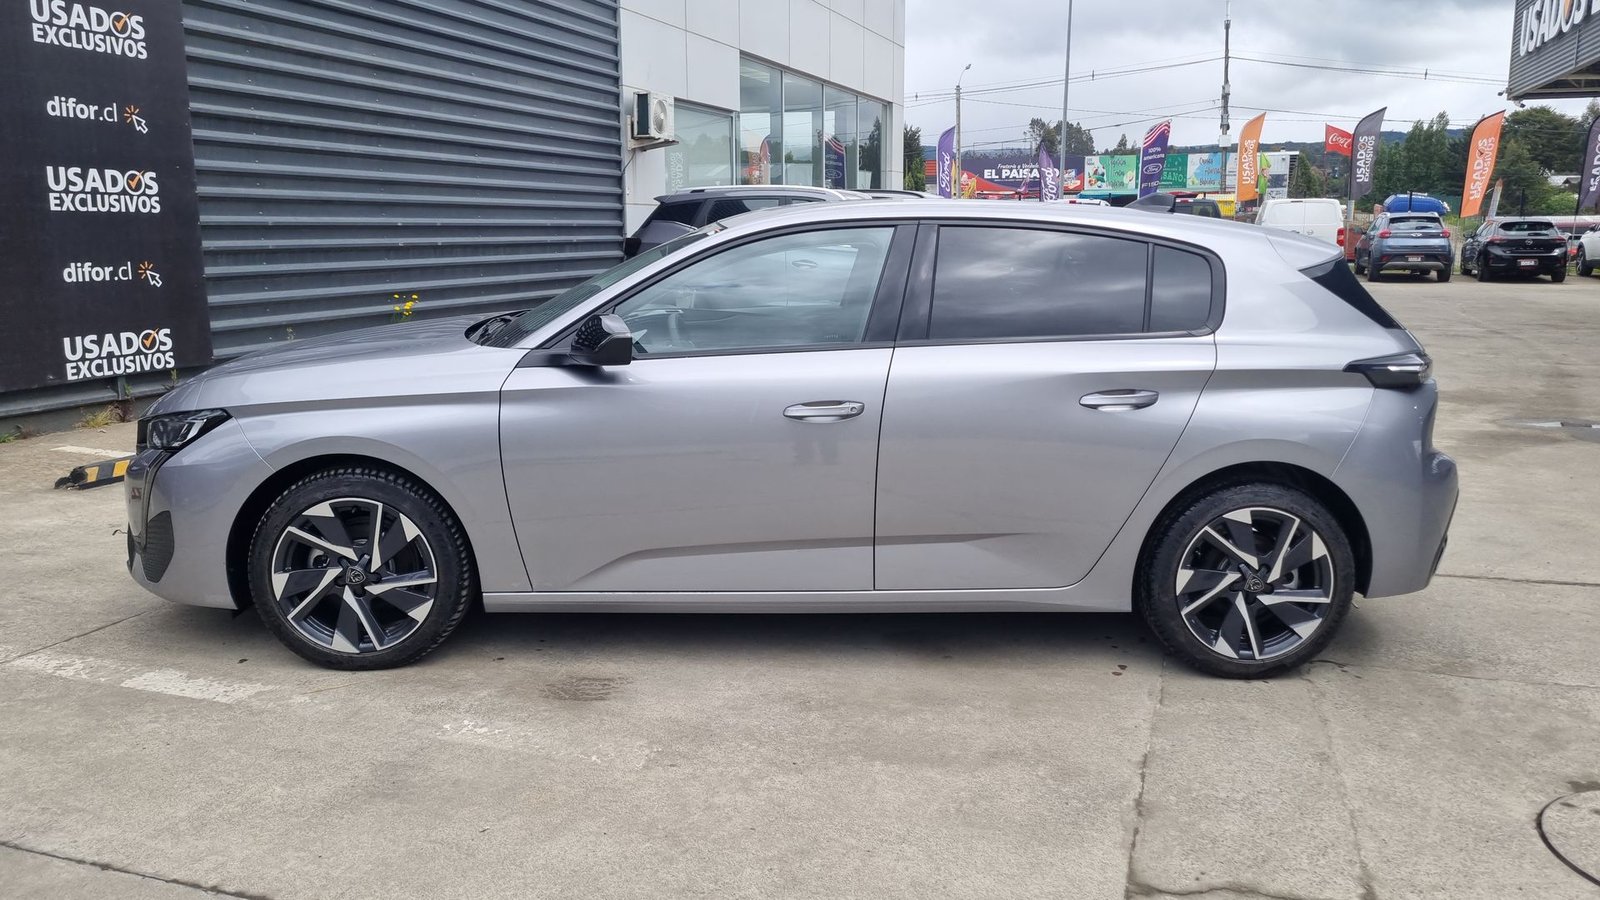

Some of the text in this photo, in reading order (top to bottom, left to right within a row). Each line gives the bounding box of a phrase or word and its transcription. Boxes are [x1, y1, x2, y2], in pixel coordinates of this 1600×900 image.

[29, 0, 145, 39] USADOS
[32, 22, 147, 59] EXCLUSIVOS
[46, 96, 118, 122] difor.cl
[939, 151, 951, 193] Ford
[983, 169, 999, 179] EL
[1242, 139, 1251, 184] USADOS
[1357, 135, 1368, 183] USADOS
[46, 166, 158, 195] USADOS
[49, 192, 160, 214] EXCLUSIVOS
[63, 261, 132, 284] difor.cl
[63, 328, 173, 361] USADOS
[65, 352, 175, 381] EXCLUSIVOS
